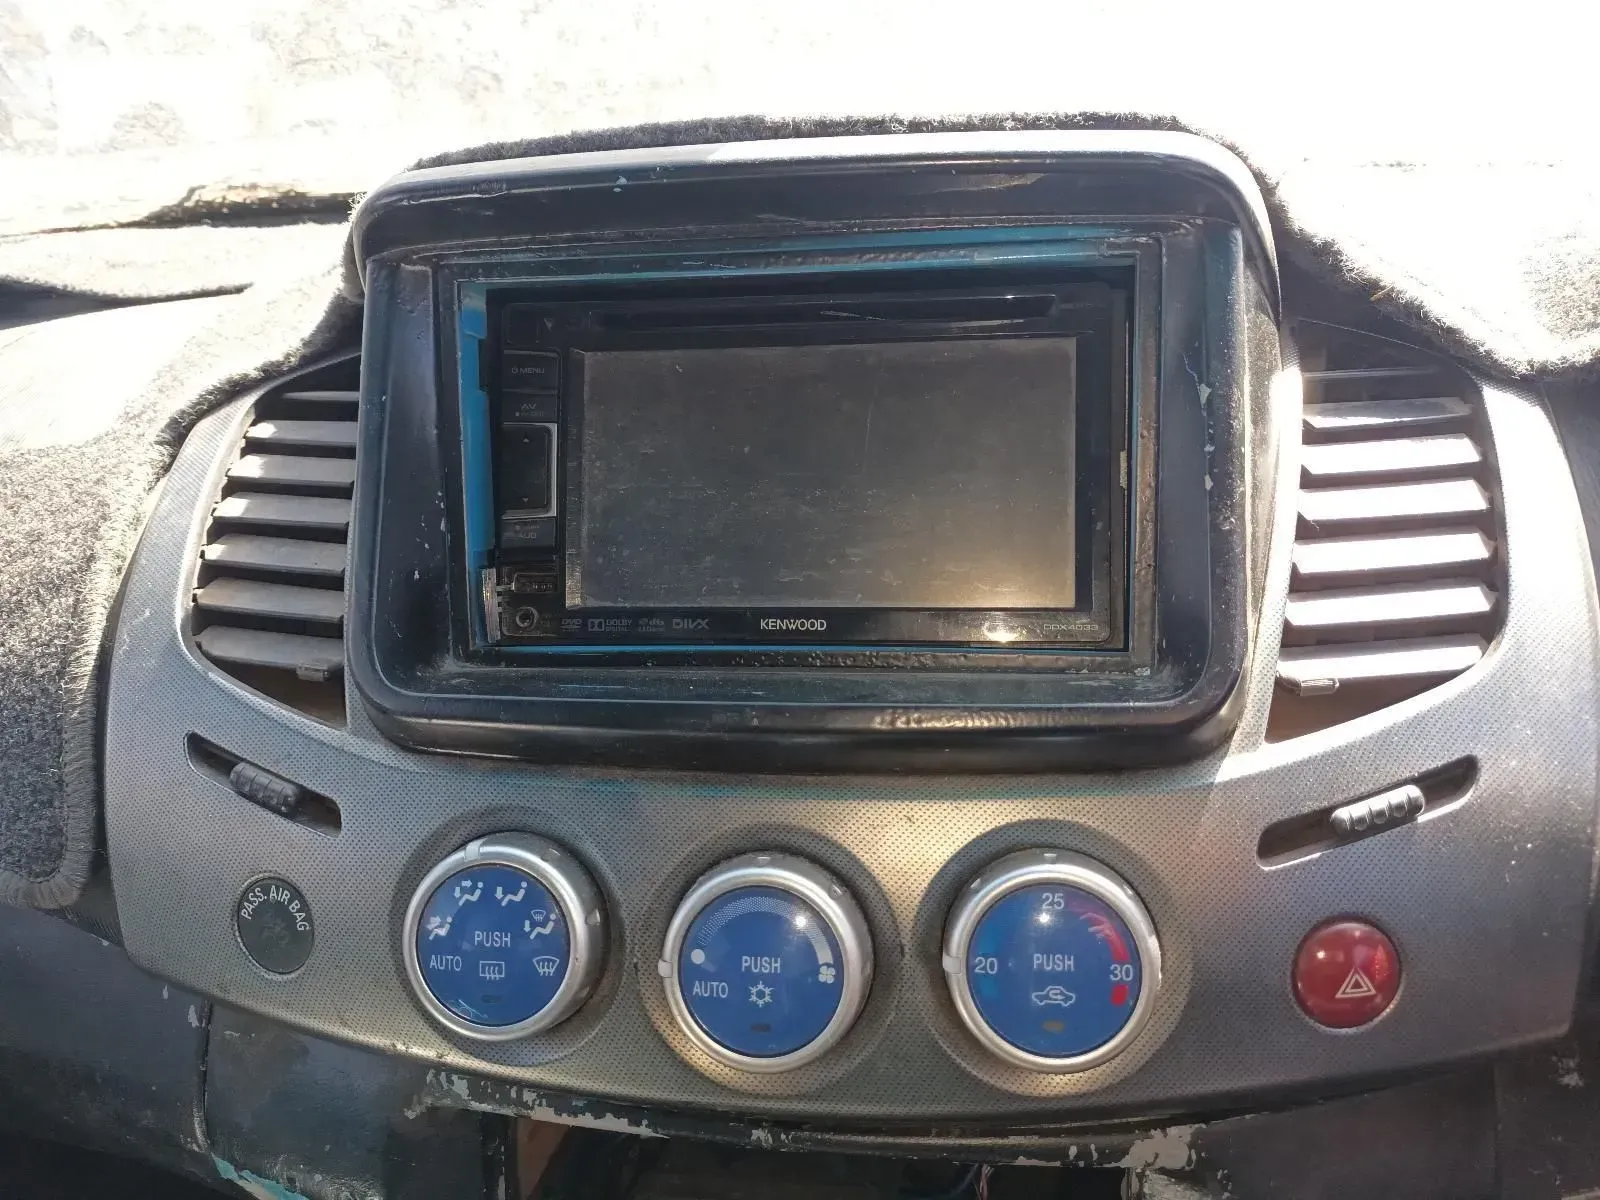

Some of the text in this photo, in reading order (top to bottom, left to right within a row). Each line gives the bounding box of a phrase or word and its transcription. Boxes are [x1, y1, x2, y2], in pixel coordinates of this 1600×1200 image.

[606, 618, 632, 626] DOLBY
[760, 618, 827, 631] KENWOOD
[241, 885, 310, 931] PASS. AIR BAG
[1042, 892, 1065, 910] 25
[474, 930, 511, 948] PUSH
[429, 954, 463, 972] AUTO
[741, 955, 781, 974] PUSH
[974, 956, 998, 975] 20
[1033, 953, 1075, 972] PUSH
[1109, 963, 1134, 982] 30
[692, 980, 729, 999] AUTO
